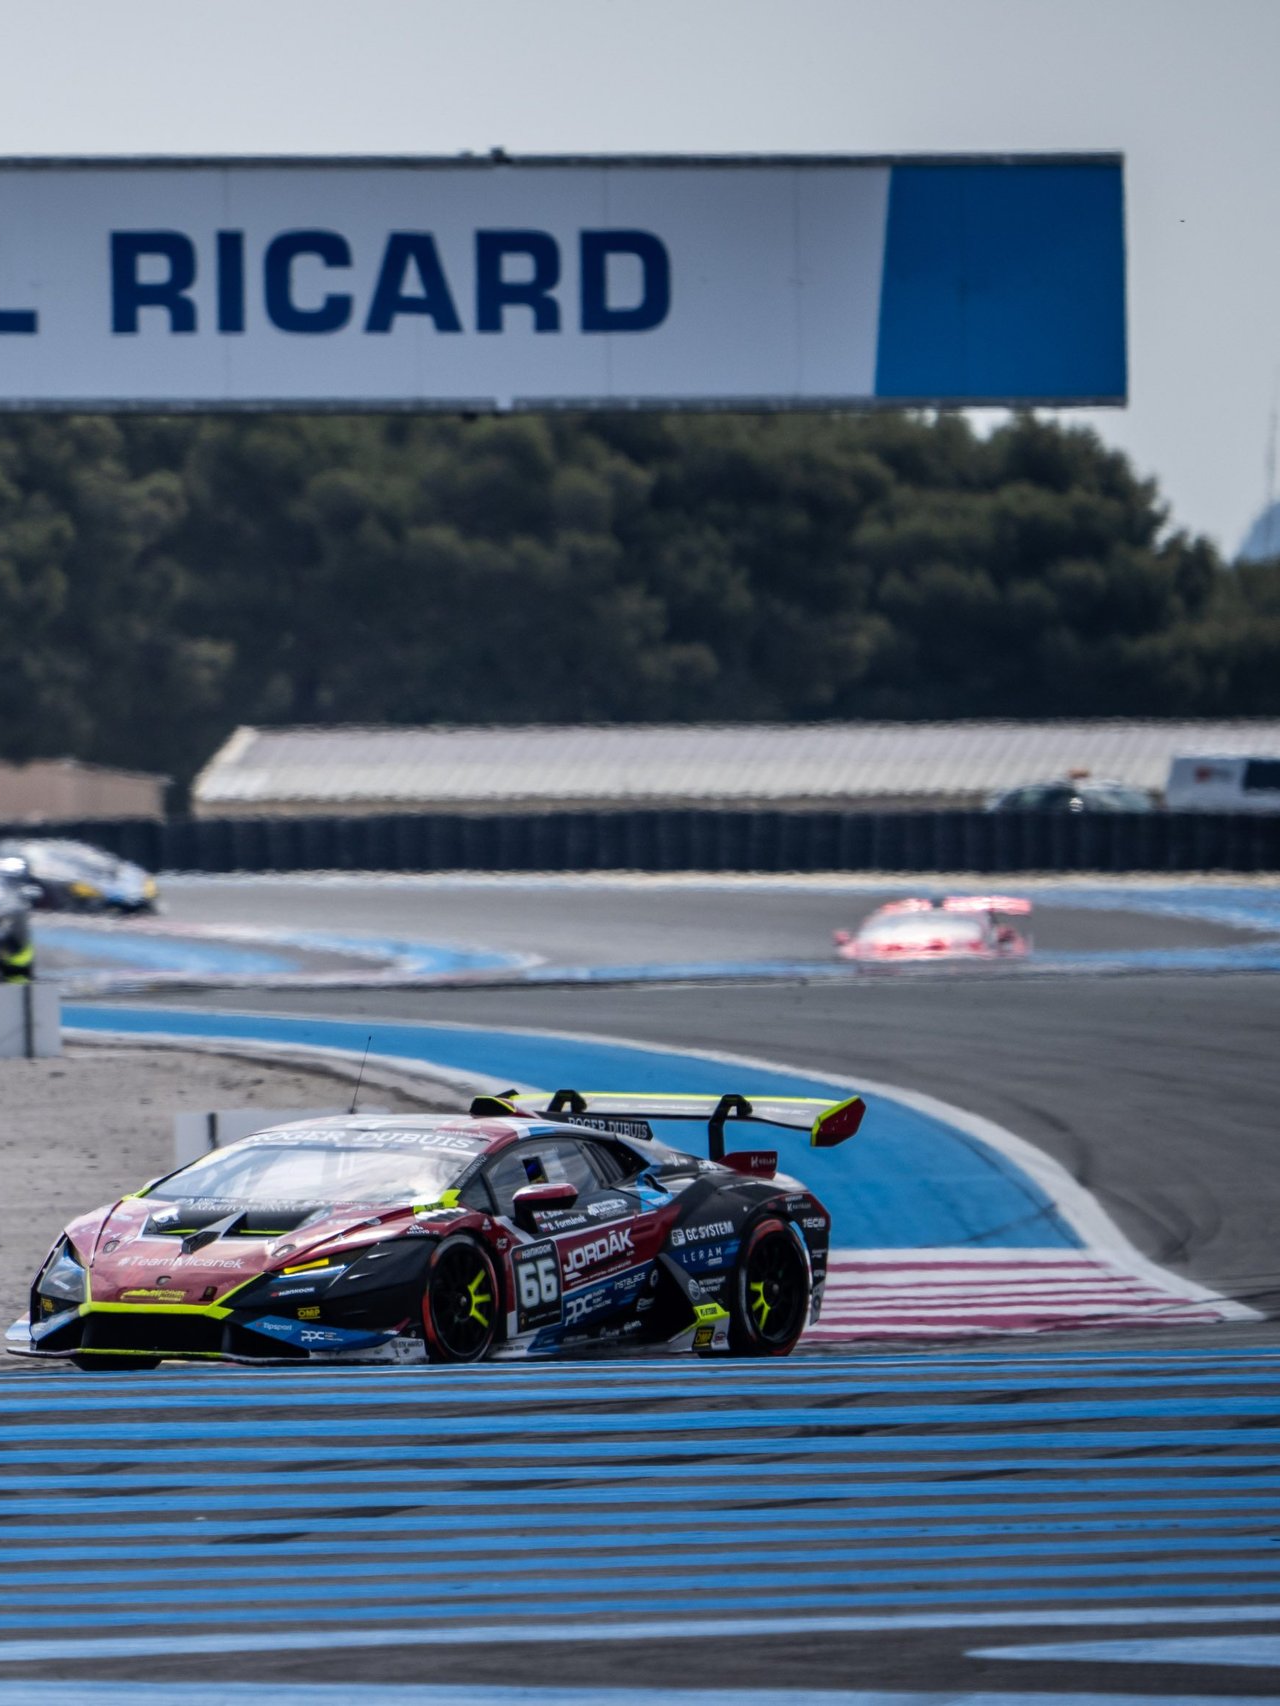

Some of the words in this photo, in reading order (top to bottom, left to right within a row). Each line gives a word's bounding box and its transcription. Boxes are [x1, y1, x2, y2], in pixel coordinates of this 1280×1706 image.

[109, 228, 675, 336] RICARD
[349, 1131, 475, 1150] DUBUIS
[519, 1257, 558, 1308] 66
[297, 1308, 321, 1318] OMP
